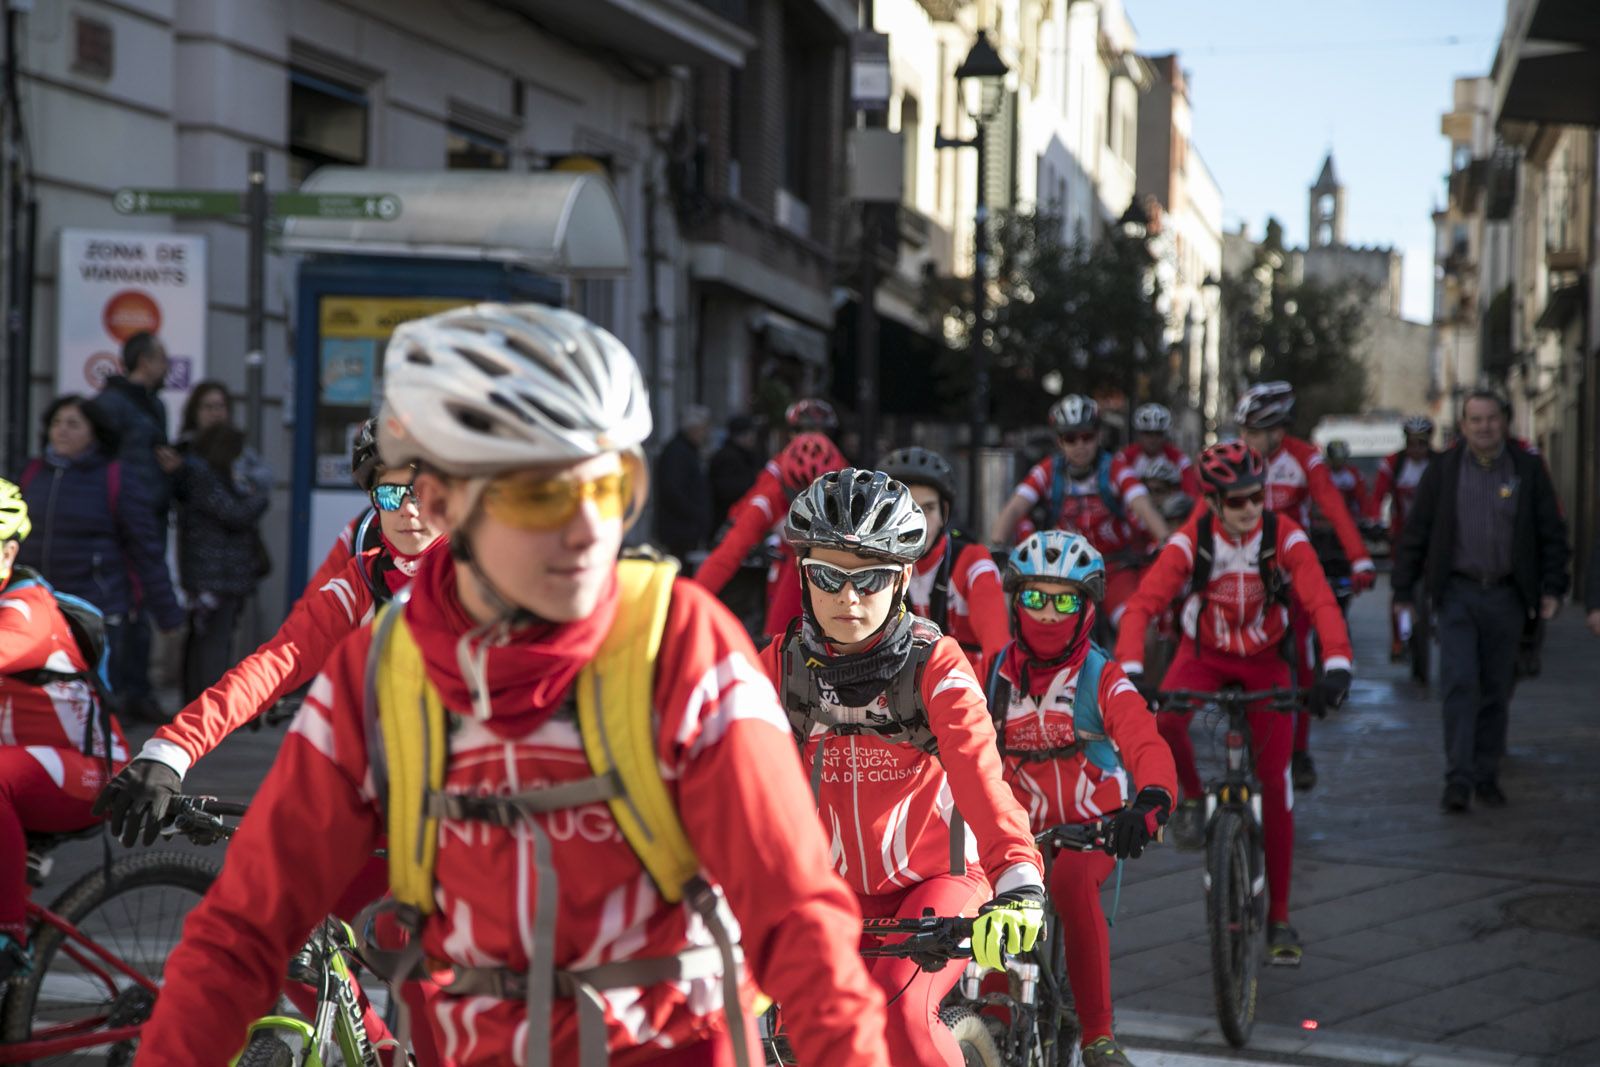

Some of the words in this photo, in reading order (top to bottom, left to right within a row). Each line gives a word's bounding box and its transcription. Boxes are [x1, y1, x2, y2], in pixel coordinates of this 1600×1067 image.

[86, 241, 144, 261] ZONA
[156, 243, 185, 262] DE
[81, 264, 186, 285] VIANANTS
[845, 756, 899, 769] CUGAT
